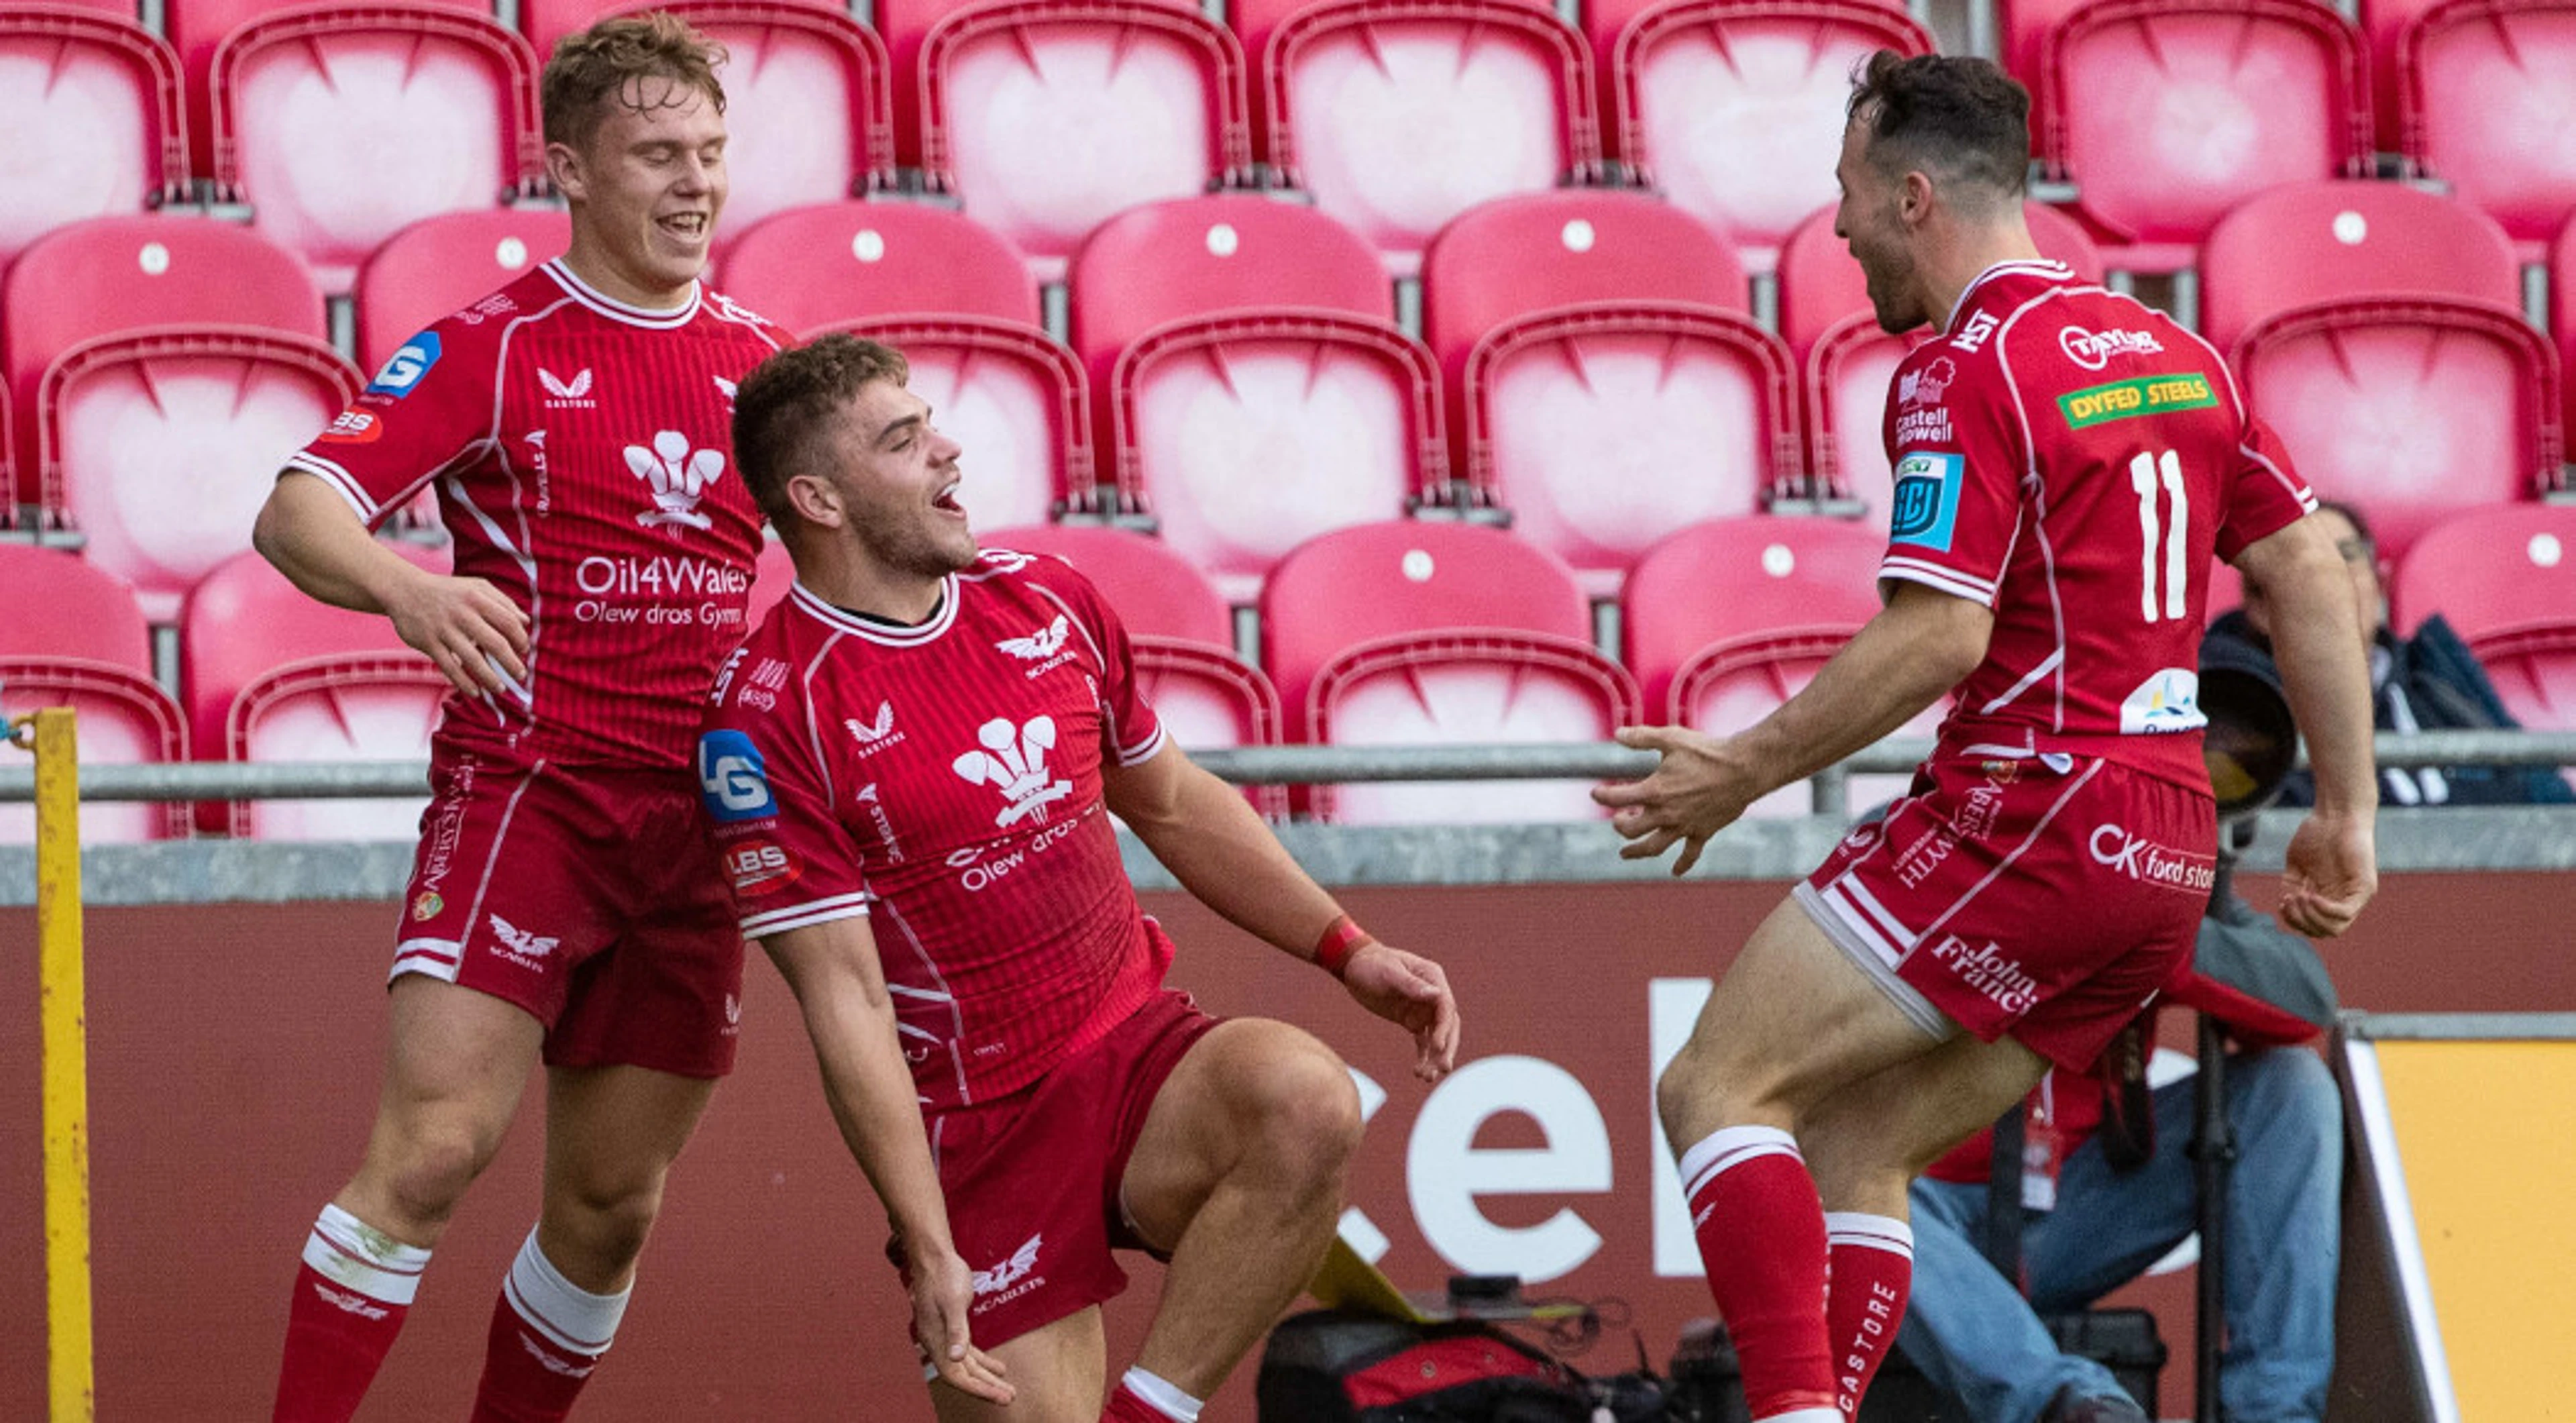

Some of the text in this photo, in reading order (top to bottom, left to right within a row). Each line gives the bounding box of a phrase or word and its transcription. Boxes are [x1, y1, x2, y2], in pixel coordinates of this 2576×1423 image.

[1949, 308, 2000, 354] HST
[2069, 380, 2208, 420] DYFED STEELS
[2130, 449, 2188, 623] 11
[574, 600, 639, 623] Olew
[645, 604, 693, 624] dros
[961, 849, 1025, 891] Olew
[2090, 823, 2147, 879] CK
[2147, 849, 2185, 883] food
[1931, 934, 2038, 1017] Franci
[1967, 940, 2037, 997] John
[973, 1277, 1046, 1316] SCARLETS
[1839, 1281, 1896, 1412] CASTORE
